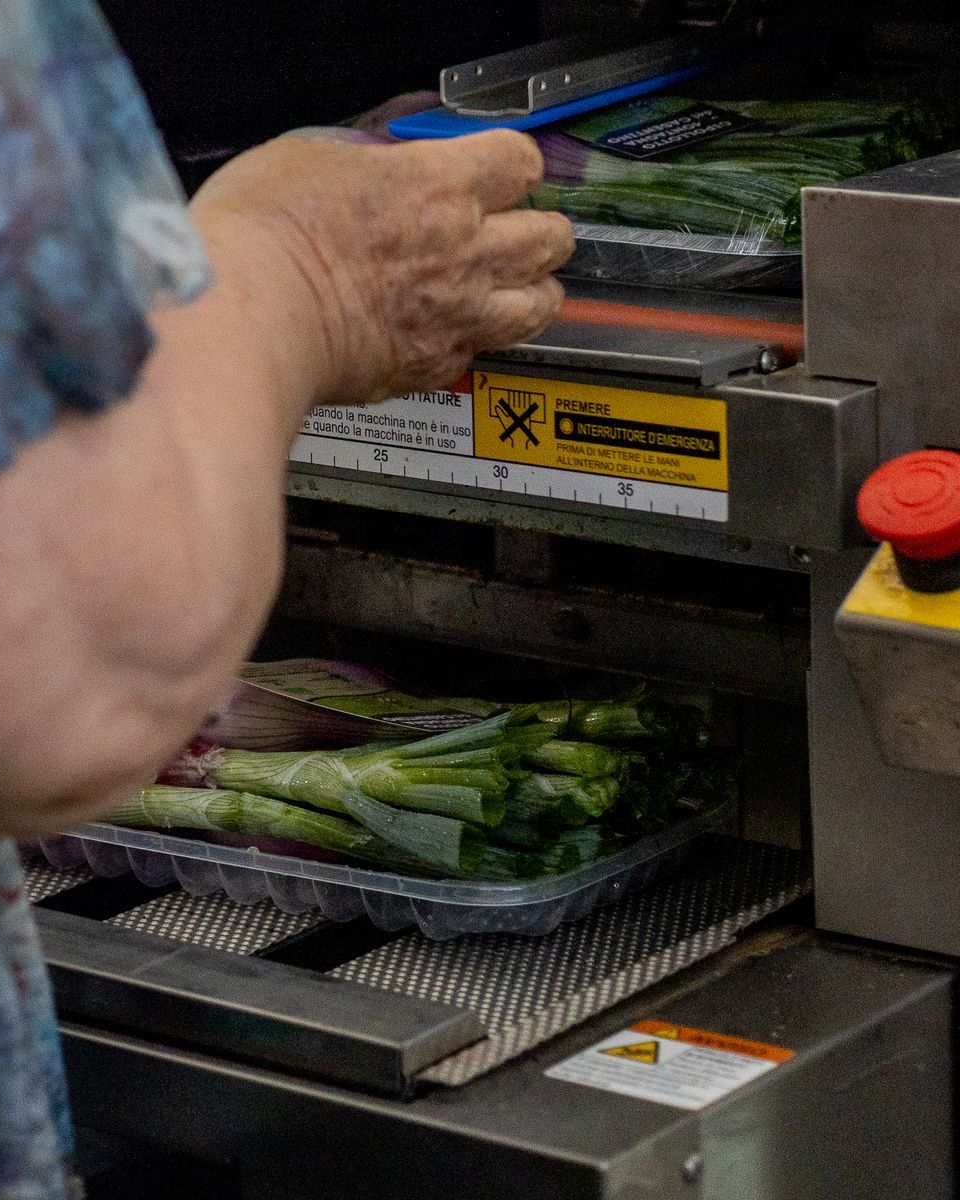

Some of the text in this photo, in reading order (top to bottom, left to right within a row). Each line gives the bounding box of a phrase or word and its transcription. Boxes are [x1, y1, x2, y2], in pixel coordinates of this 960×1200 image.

[555, 398, 611, 416] PREMERE
[345, 410, 355, 422] la
[357, 413, 406, 429] macchina
[408, 419, 428, 431] non
[430, 420, 437, 433] è
[440, 421, 449, 434] in
[452, 426, 471, 437] uso
[313, 421, 350, 435] quando
[352, 424, 361, 436] la
[365, 427, 413, 444] macchina
[415, 432, 423, 445] è
[425, 434, 434, 446] in
[437, 438, 456, 449] uso
[577, 422, 647, 444] INTERRUTTORE
[373, 448, 390, 463] 25
[556, 443, 585, 455] PRIMA
[586, 446, 596, 456] DI
[598, 448, 641, 462] METTERE
[643, 454, 655, 465] LE
[492, 465, 509, 480] 30
[617, 462, 645, 475] DELLA
[617, 482, 635, 496] 35
